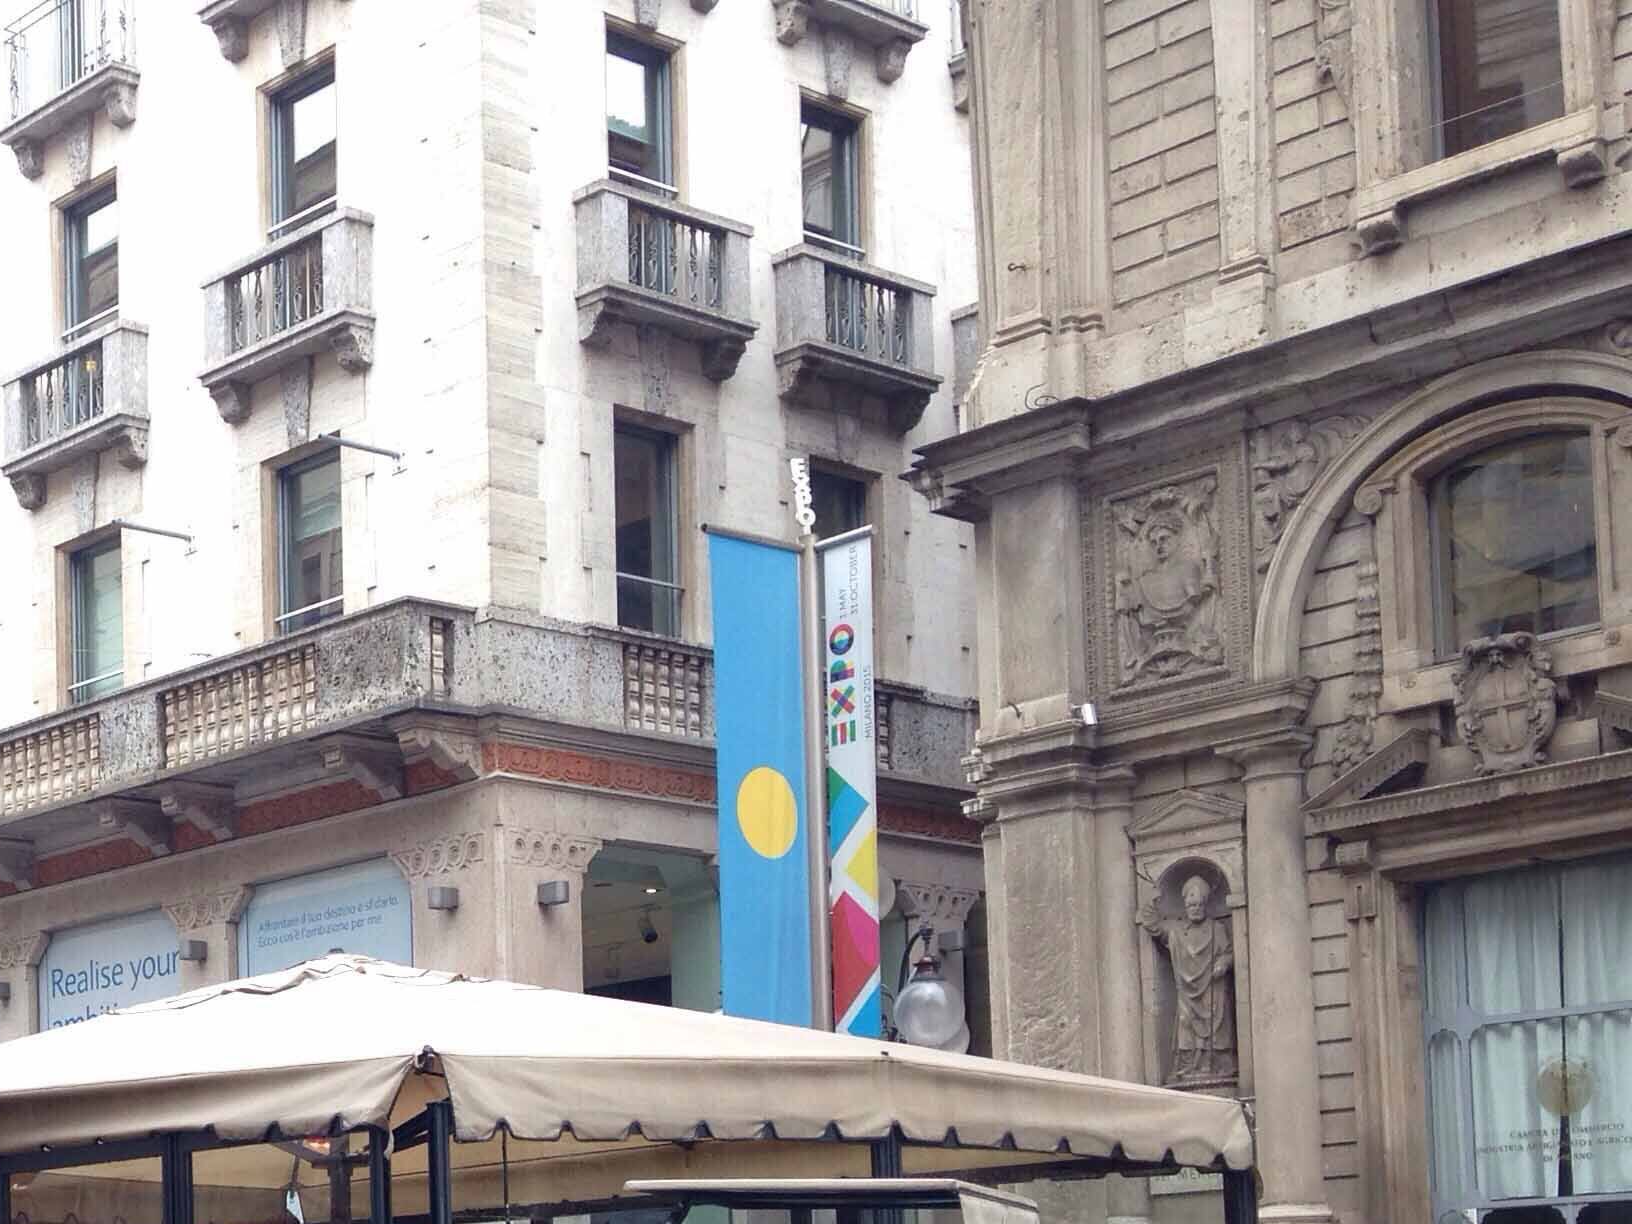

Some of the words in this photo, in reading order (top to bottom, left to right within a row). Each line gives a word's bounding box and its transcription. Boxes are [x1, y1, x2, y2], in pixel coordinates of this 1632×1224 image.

[829, 623, 856, 747] EXPO
[863, 665, 872, 692] 2015
[863, 694, 872, 739] MILANO
[52, 959, 124, 998] Realise
[129, 950, 180, 991] your
